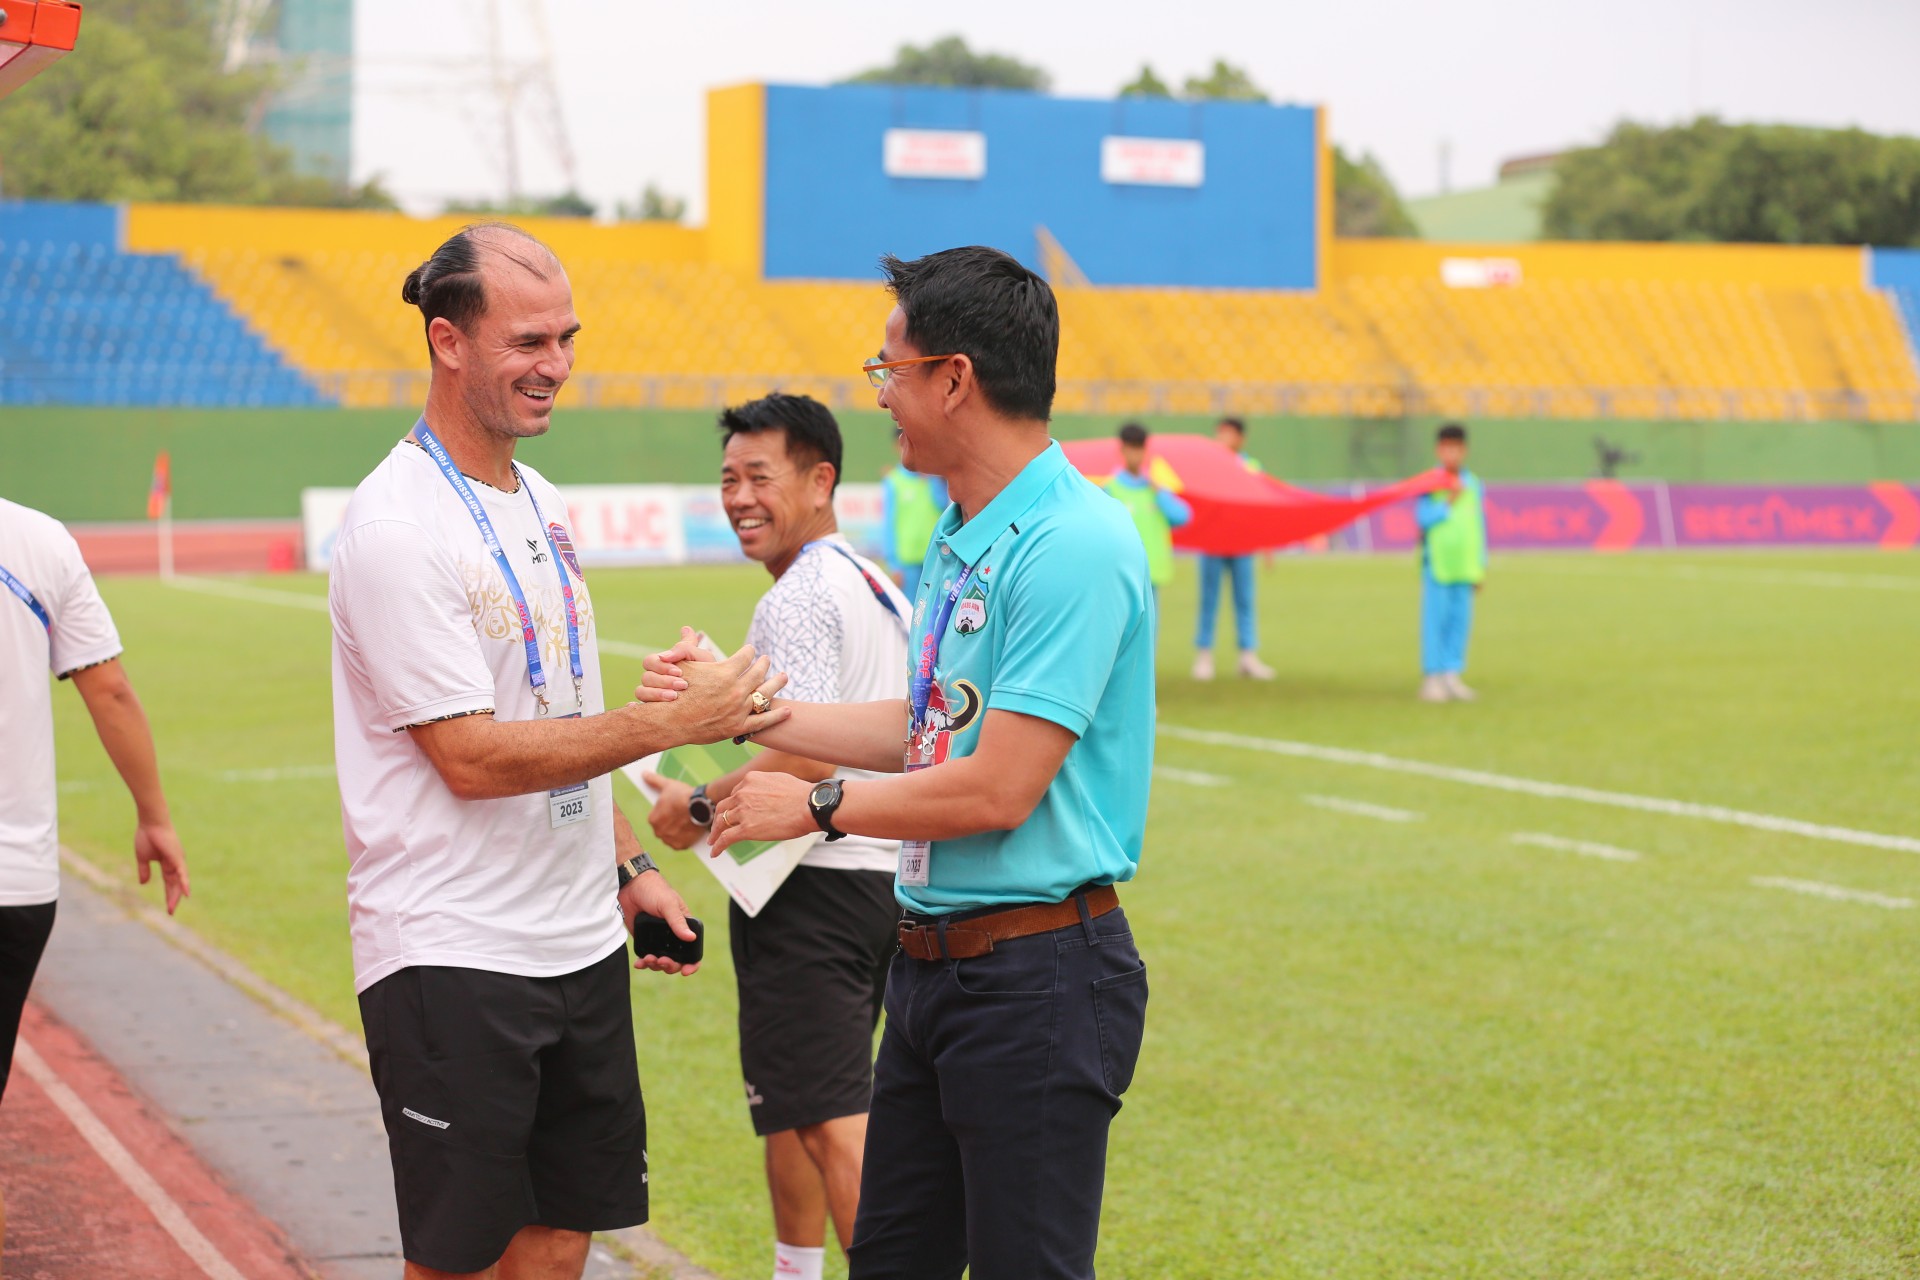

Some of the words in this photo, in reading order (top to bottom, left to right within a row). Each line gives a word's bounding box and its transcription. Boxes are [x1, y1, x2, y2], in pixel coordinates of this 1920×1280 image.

[421, 431, 450, 467] FOOTBALL
[446, 466, 485, 521] PROFESSIONAL
[480, 521, 502, 558] VIETNAM
[516, 600, 529, 627] VPF
[568, 600, 577, 627] VPF
[919, 649, 931, 679] VPF
[560, 800, 583, 818] 2023
[906, 859, 921, 873] 2023
